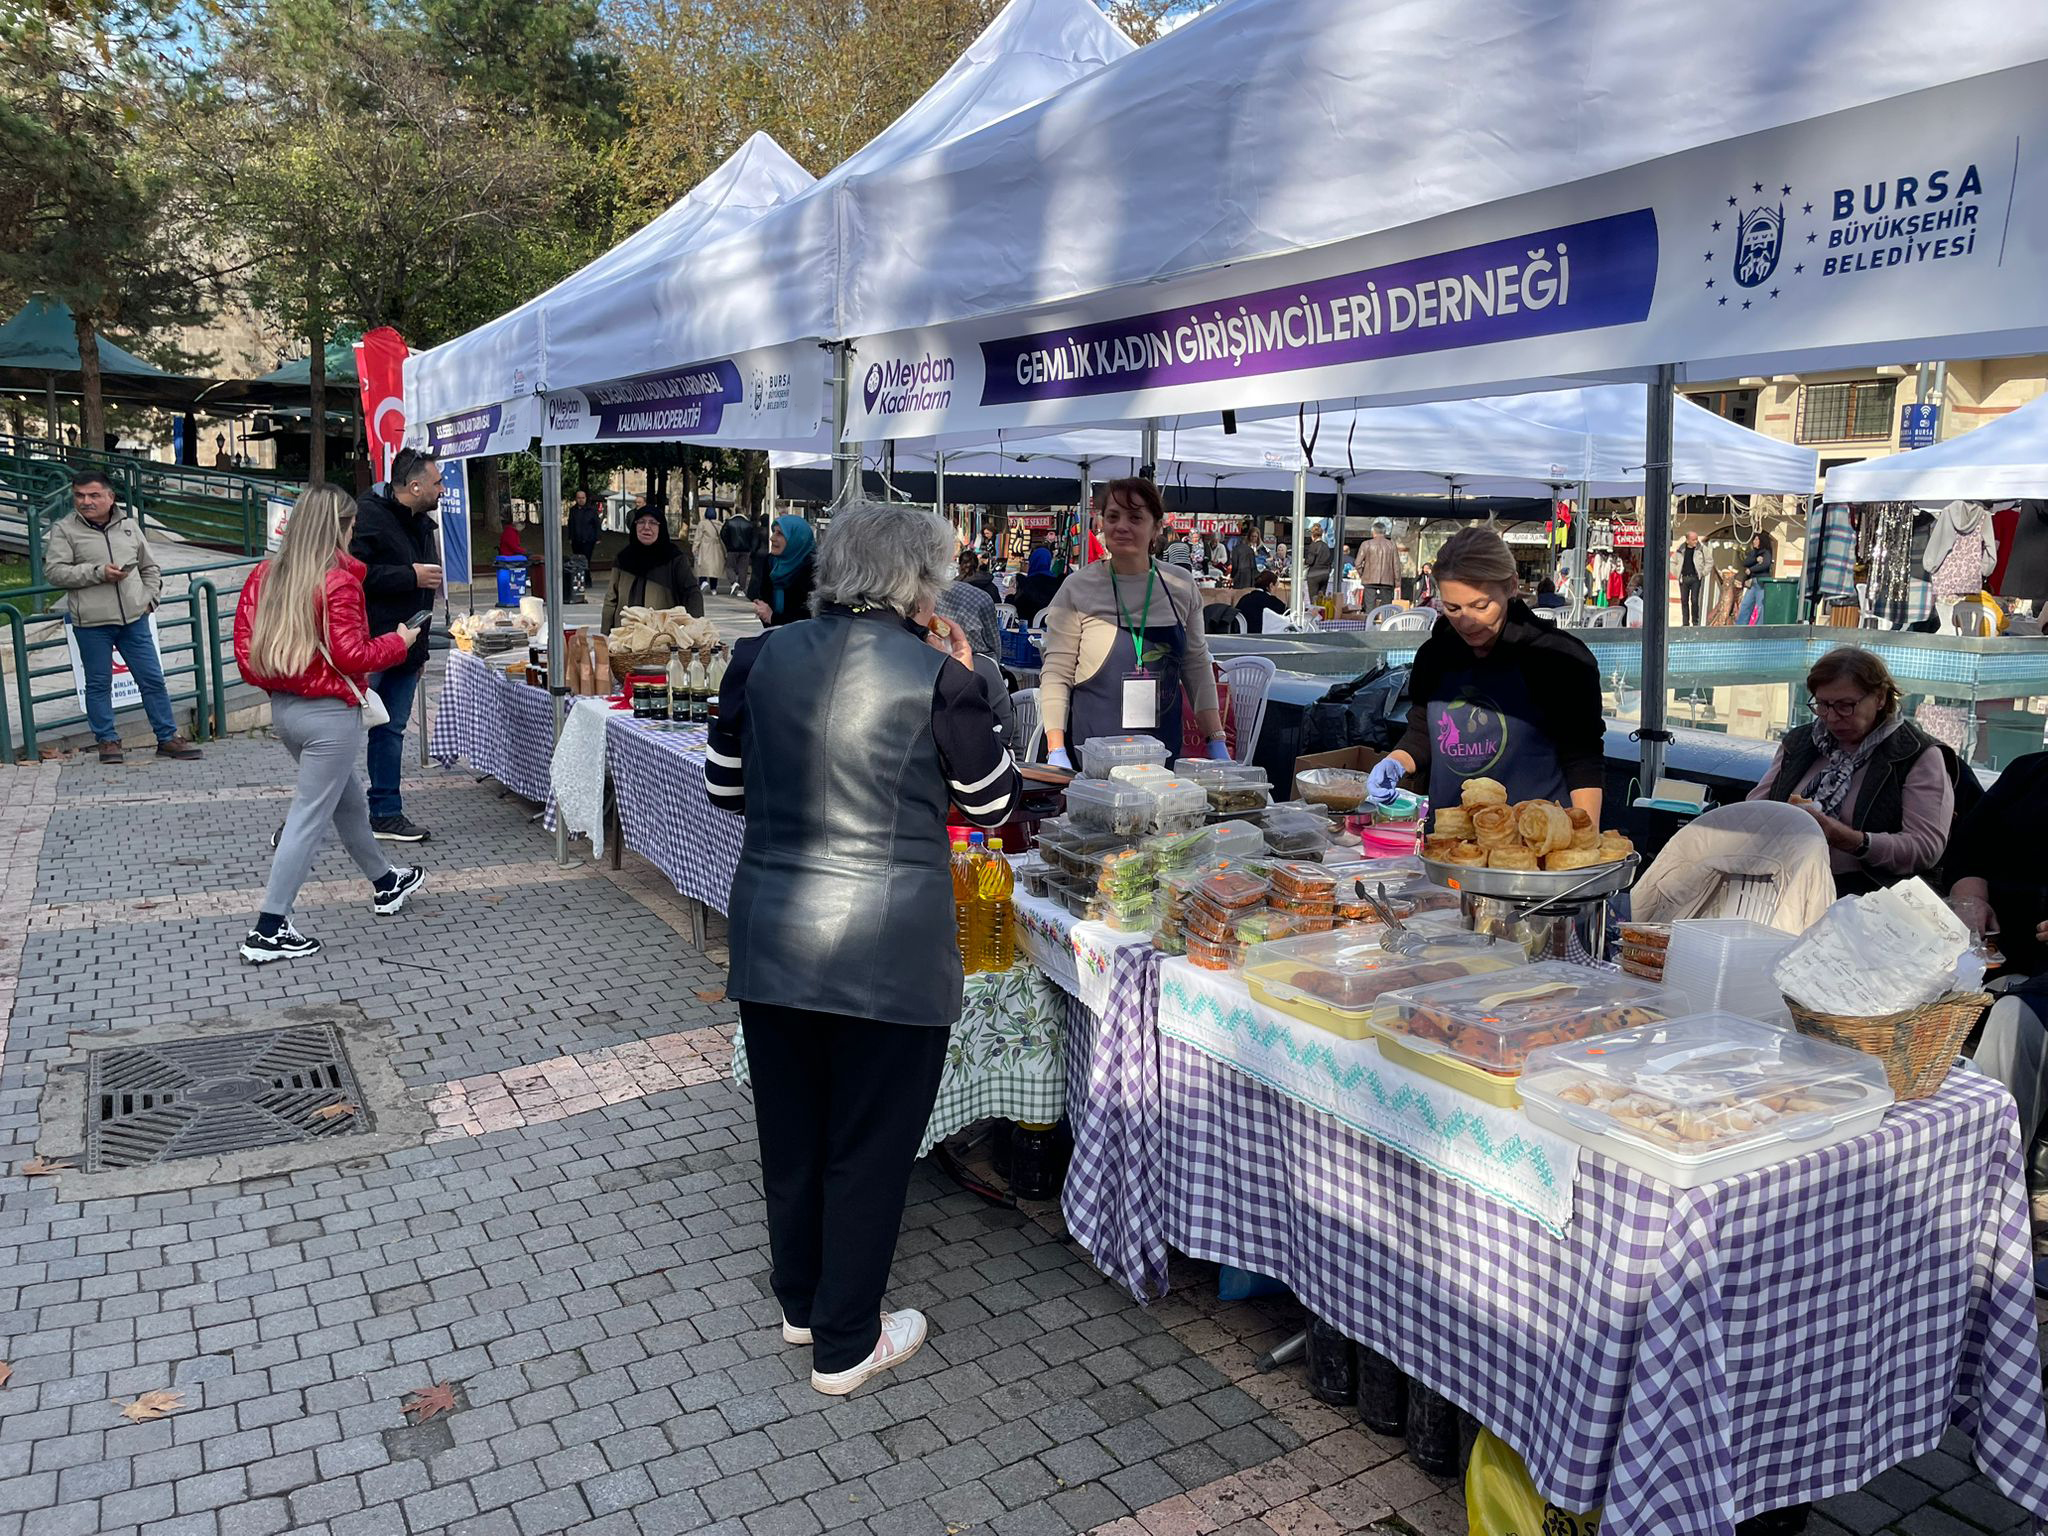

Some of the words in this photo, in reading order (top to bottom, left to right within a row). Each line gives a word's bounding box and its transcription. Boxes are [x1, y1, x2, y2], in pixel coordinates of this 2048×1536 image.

[1832, 164, 1983, 222] BURSA
[1828, 201, 1979, 249] BÜYÜKŞEHİR
[1822, 228, 1977, 277] BELEDİYESİ
[1016, 336, 1094, 386] GEMLİK
[1094, 329, 1173, 376] KADIN
[1175, 280, 1382, 368] GİRİŞİMCİLERİ
[1386, 242, 1570, 333] DERNEĞİ
[679, 372, 723, 396] TARIMSAL
[769, 373, 791, 388] BURSA
[884, 352, 955, 393] Meydan
[555, 398, 582, 418] Meydan
[879, 386, 952, 415] Kadınların
[617, 412, 653, 432] KALKINMA
[653, 402, 701, 430] KOOPERATİFİ
[1447, 739, 1497, 757] GEMLİK
